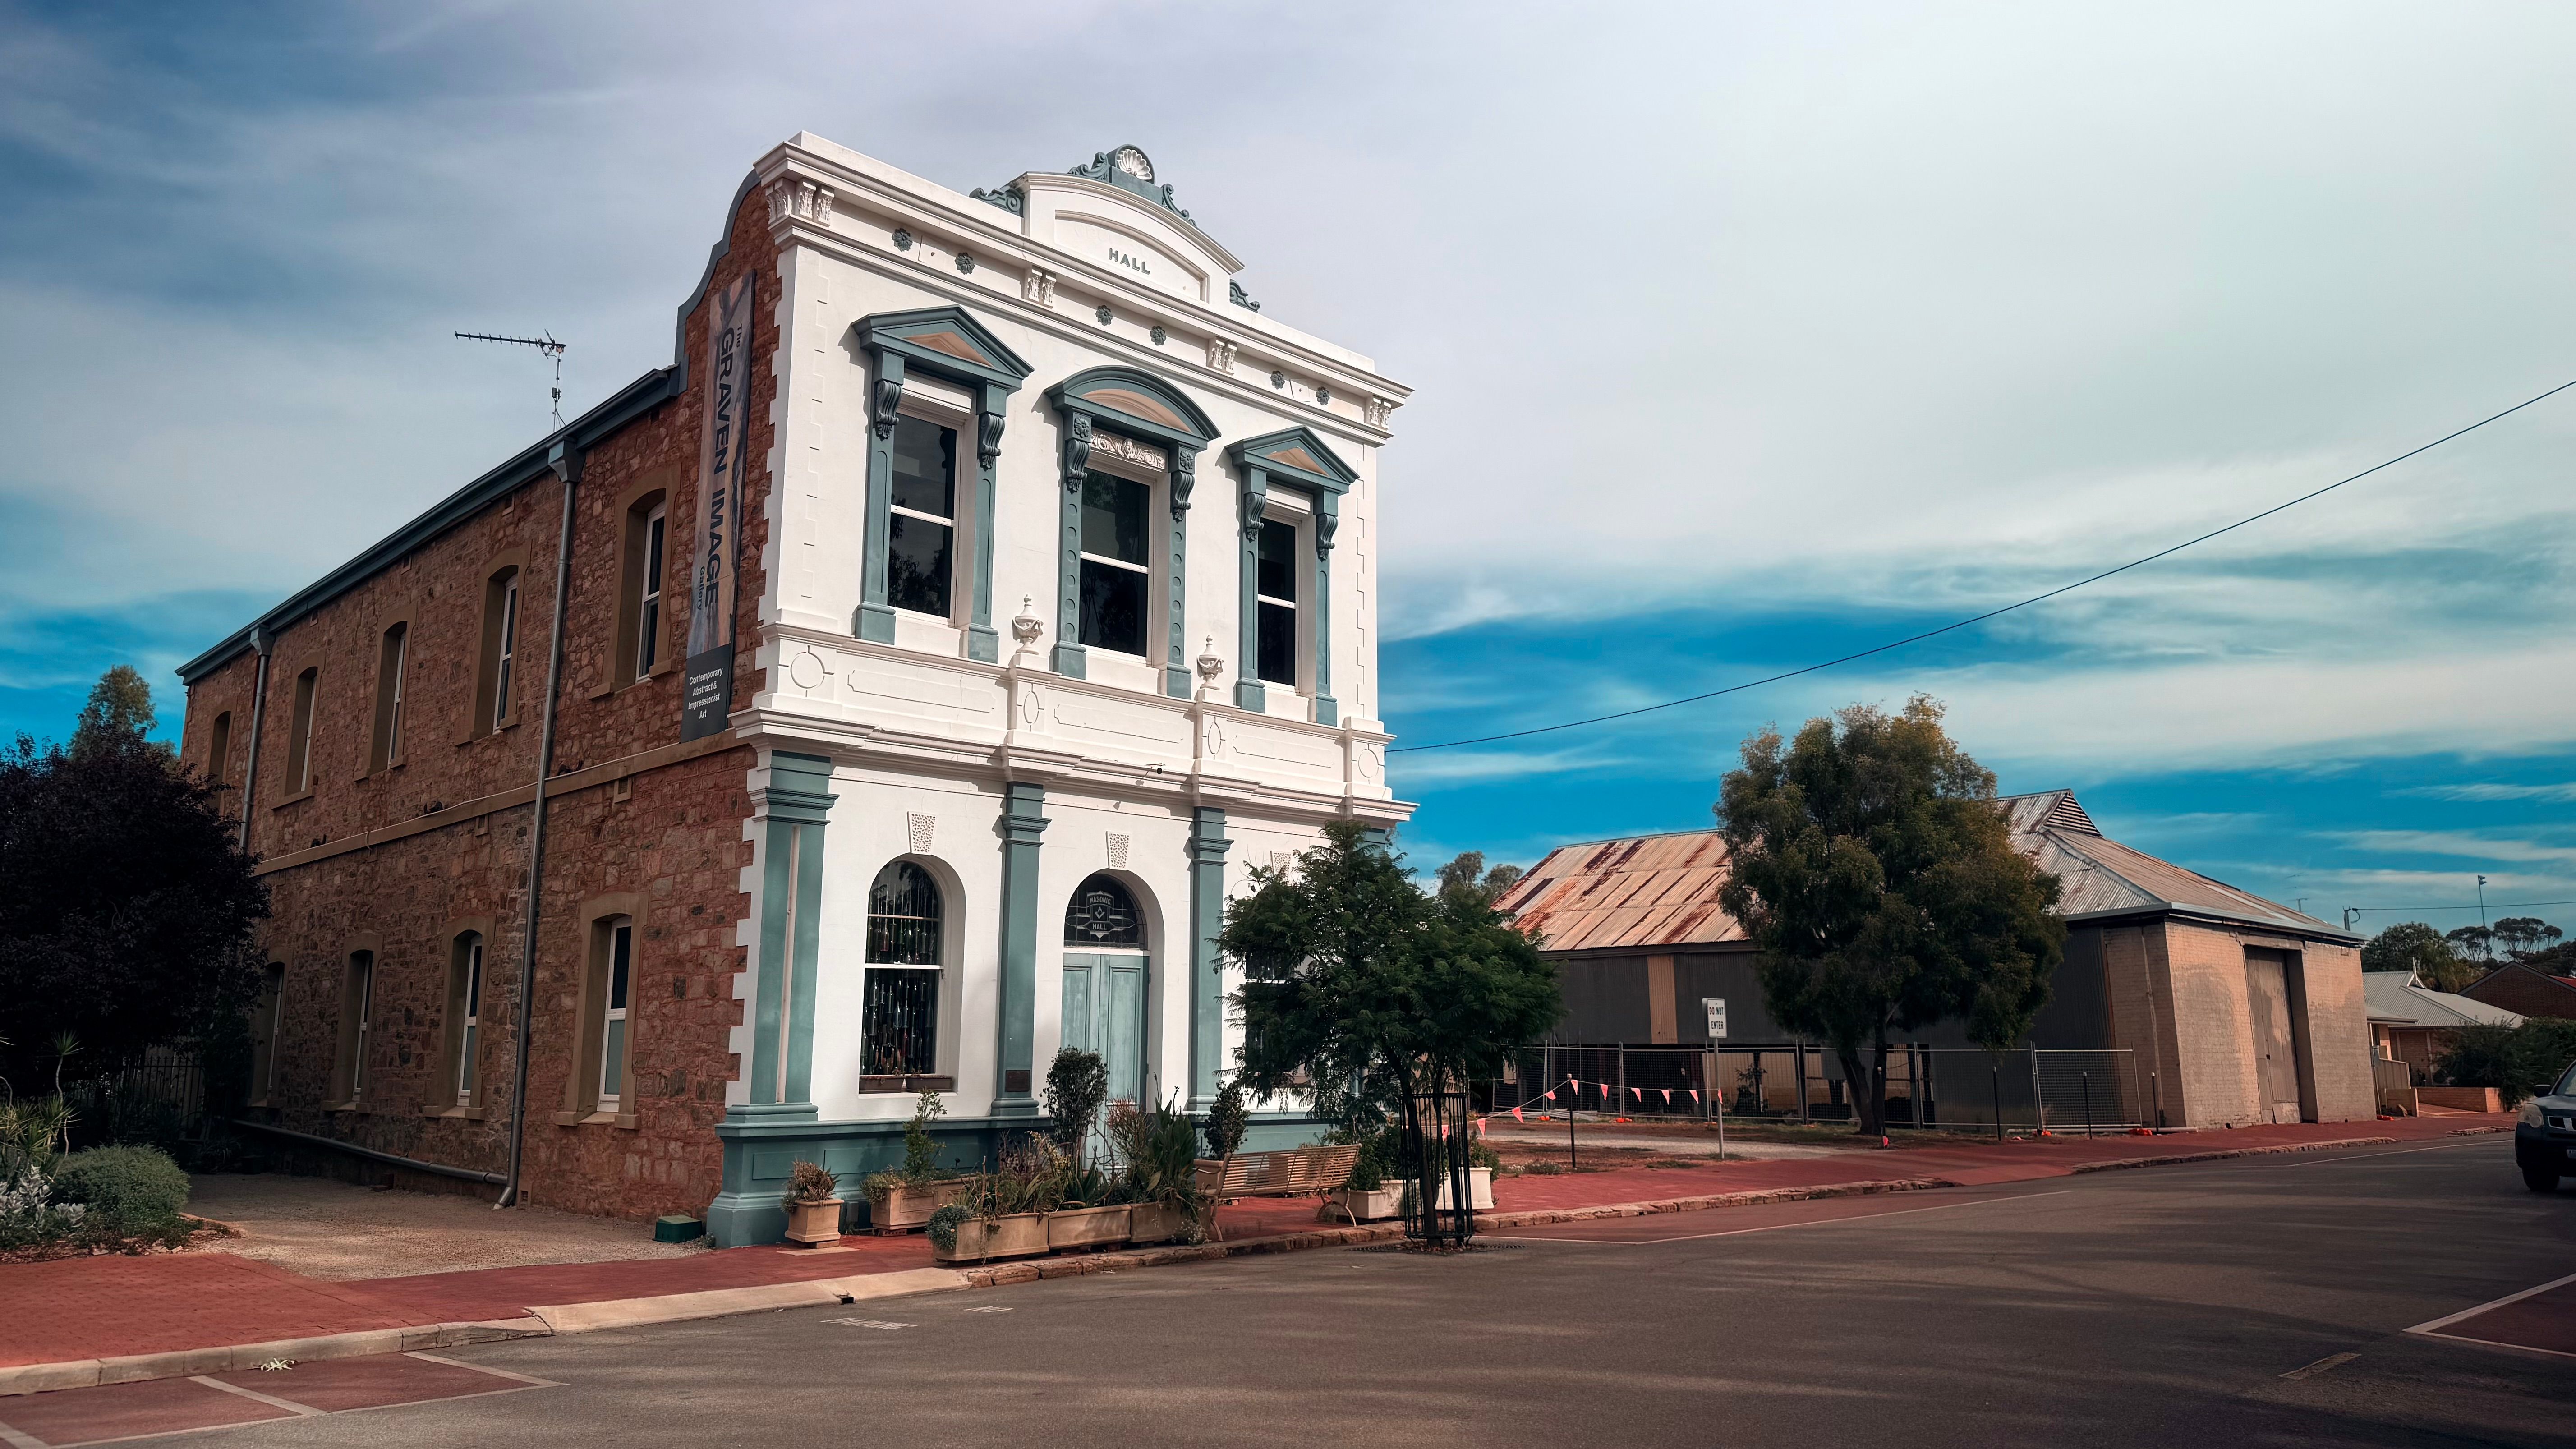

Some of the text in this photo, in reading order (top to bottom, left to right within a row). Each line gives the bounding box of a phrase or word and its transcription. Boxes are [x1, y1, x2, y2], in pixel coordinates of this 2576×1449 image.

[1109, 248, 1150, 275] HALL
[705, 327, 735, 607] GRAVEN IMAGE
[689, 667, 723, 685] Contemporary
[692, 681, 717, 696] Abstract &
[688, 692, 720, 710] Impressionist
